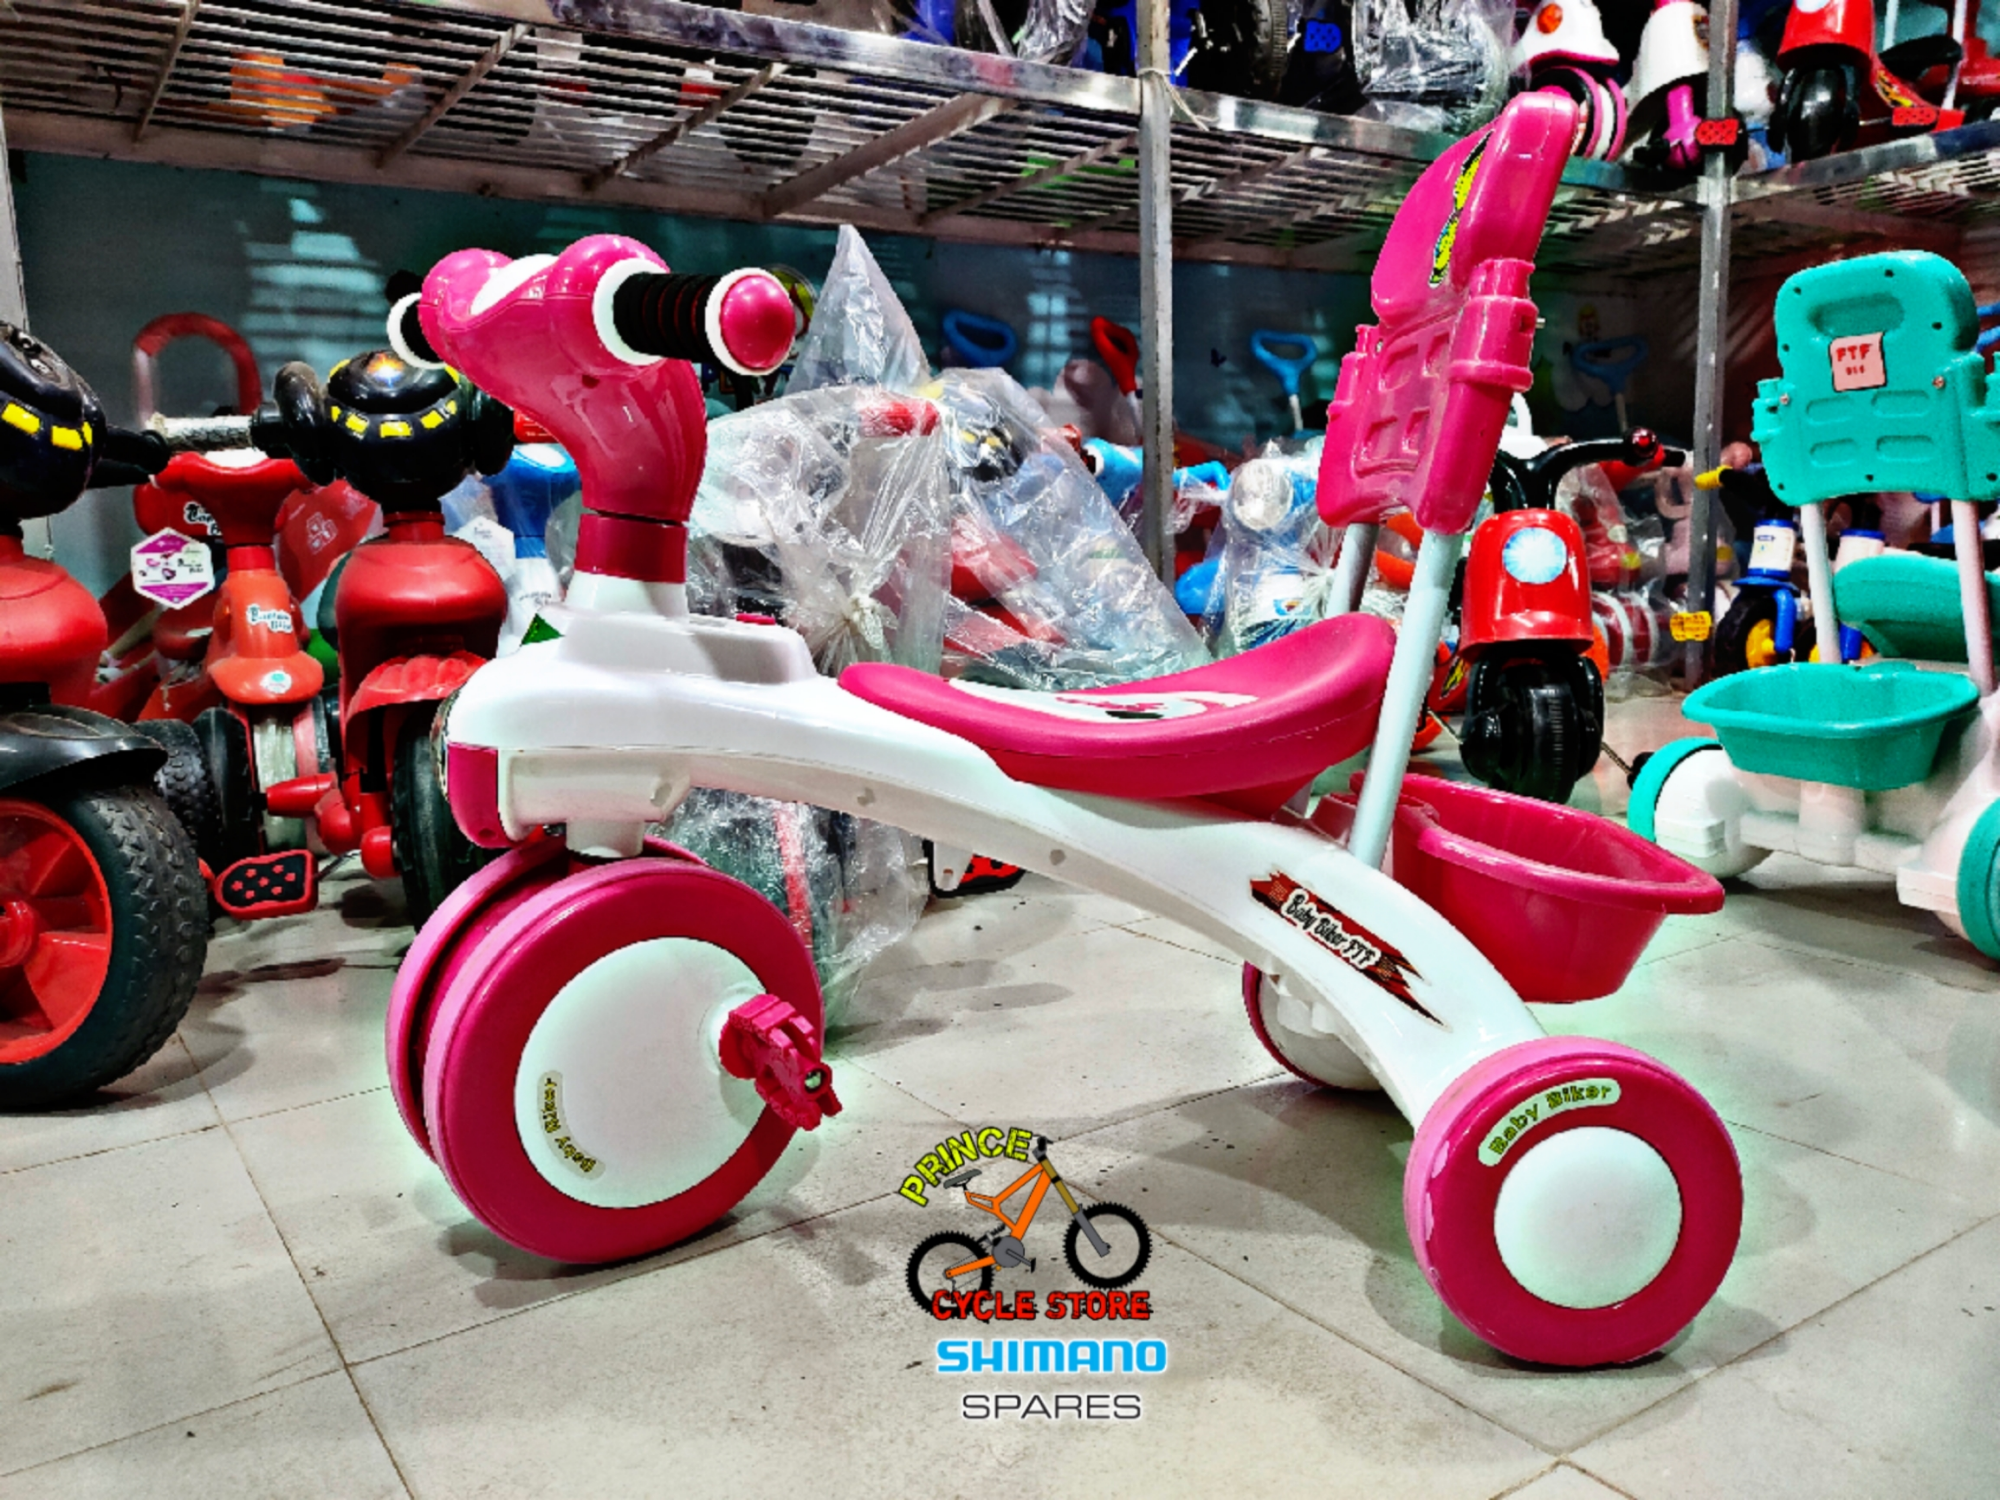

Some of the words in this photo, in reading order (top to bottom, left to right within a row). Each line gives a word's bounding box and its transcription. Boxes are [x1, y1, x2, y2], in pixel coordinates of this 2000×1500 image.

[1836, 343, 1872, 362] FTF
[1285, 893, 1317, 930] Baby
[1314, 917, 1348, 946] Biker
[1343, 938, 1376, 965] FTF
[541, 1077, 561, 1133] Biker
[1488, 1103, 1538, 1155] Baby
[1545, 1085, 1612, 1109] Biker
[554, 1136, 597, 1172] Baby
